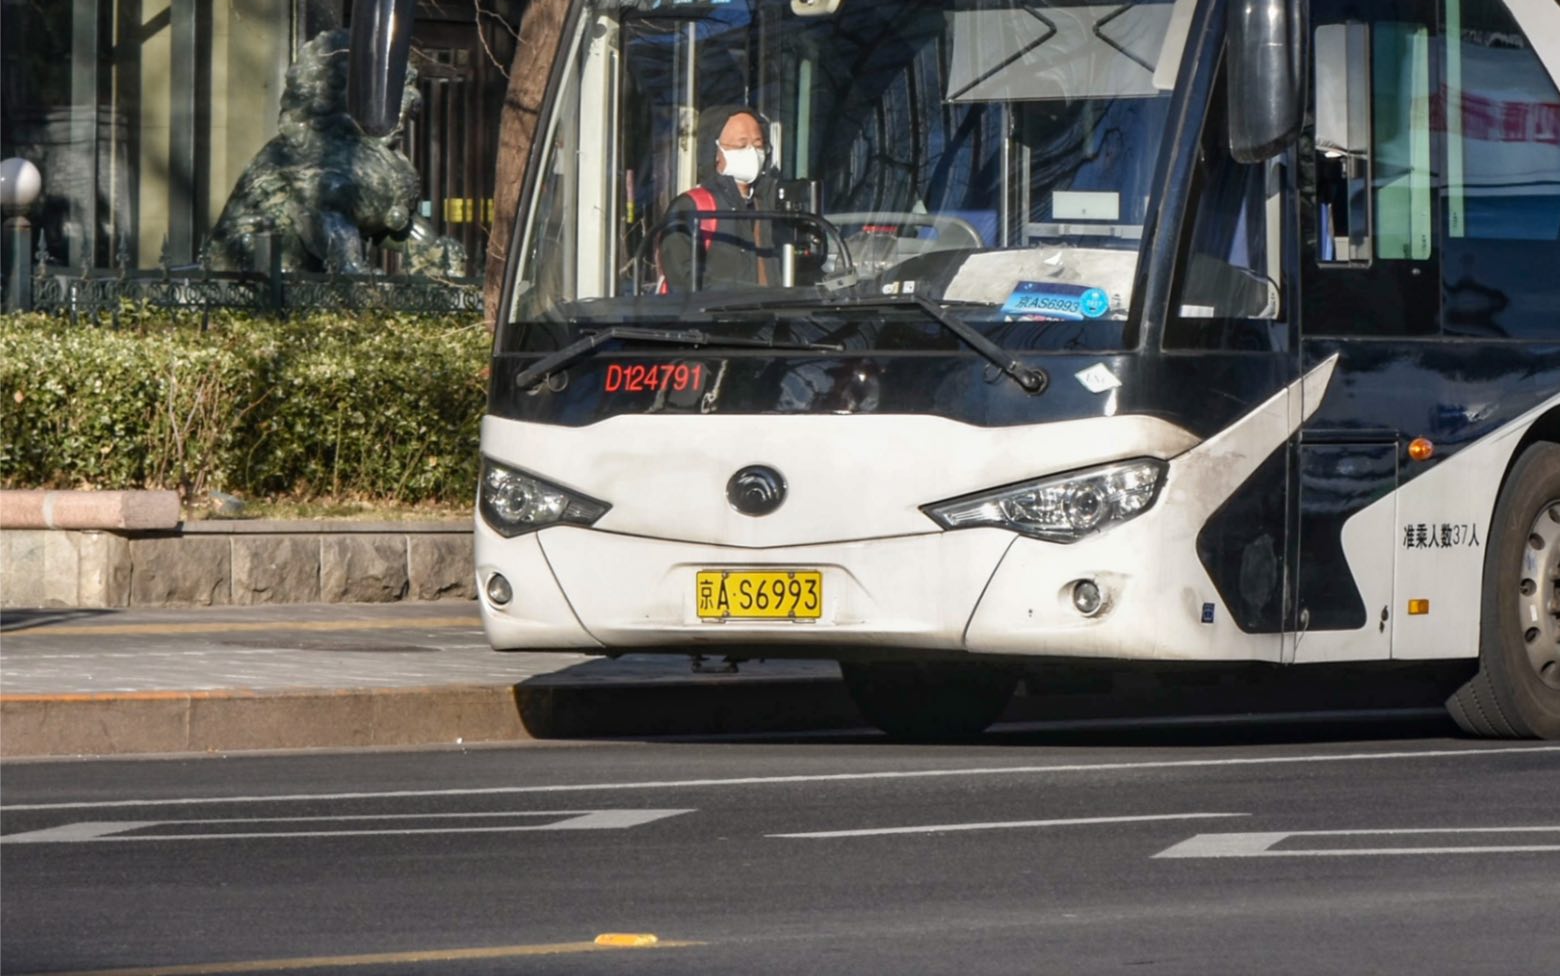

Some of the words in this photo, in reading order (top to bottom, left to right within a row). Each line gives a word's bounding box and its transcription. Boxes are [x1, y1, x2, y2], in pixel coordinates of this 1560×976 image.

[605, 363, 701, 393] D124791
[1402, 523, 1481, 550] 准乘人数37人
